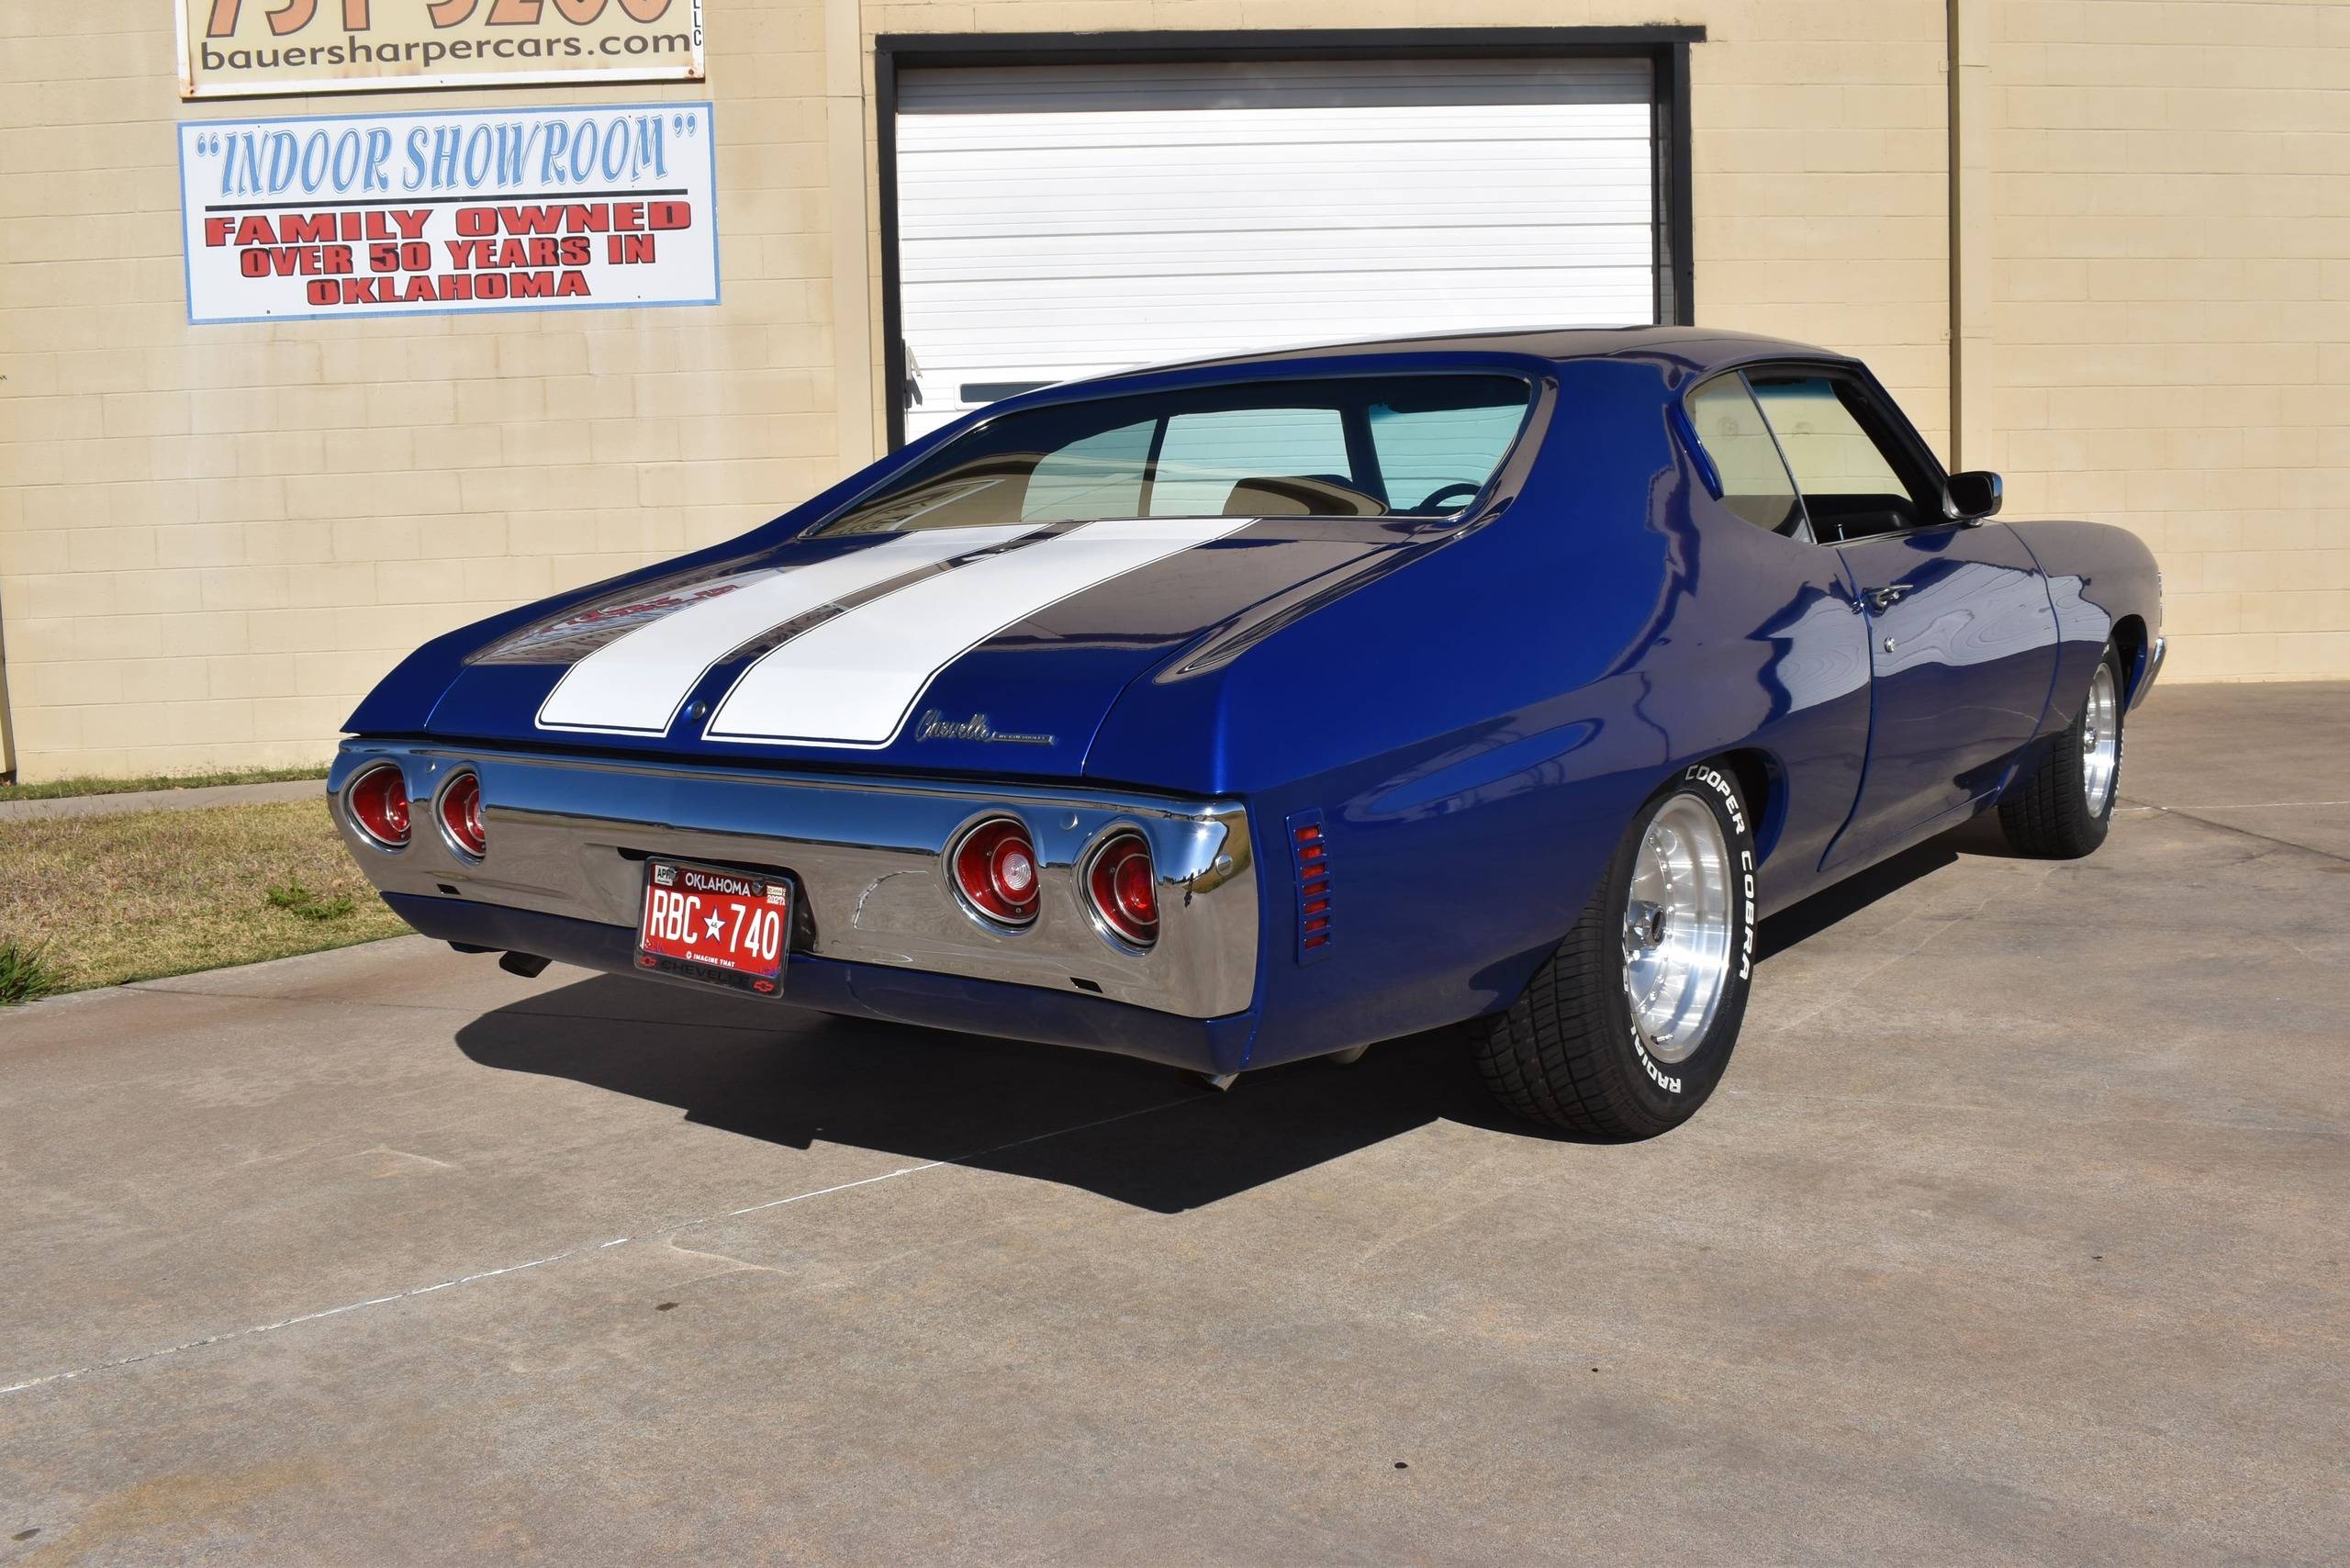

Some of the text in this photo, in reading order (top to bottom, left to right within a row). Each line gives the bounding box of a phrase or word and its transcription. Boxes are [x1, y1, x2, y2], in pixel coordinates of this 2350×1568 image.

[201, 33, 690, 71] bauersharpercars.com
[205, 200, 691, 247] FAMILY OWNED
[240, 233, 656, 277] OVER 50 YEARS IN
[307, 270, 591, 306] OKLAHOMA
[1685, 765, 1745, 834] COOPER
[685, 872, 751, 897] OKLAHOMA
[650, 889, 780, 960] RBC 740
[1740, 850, 1754, 980] COBRA
[693, 953, 735, 968] IMAGINE THAT
